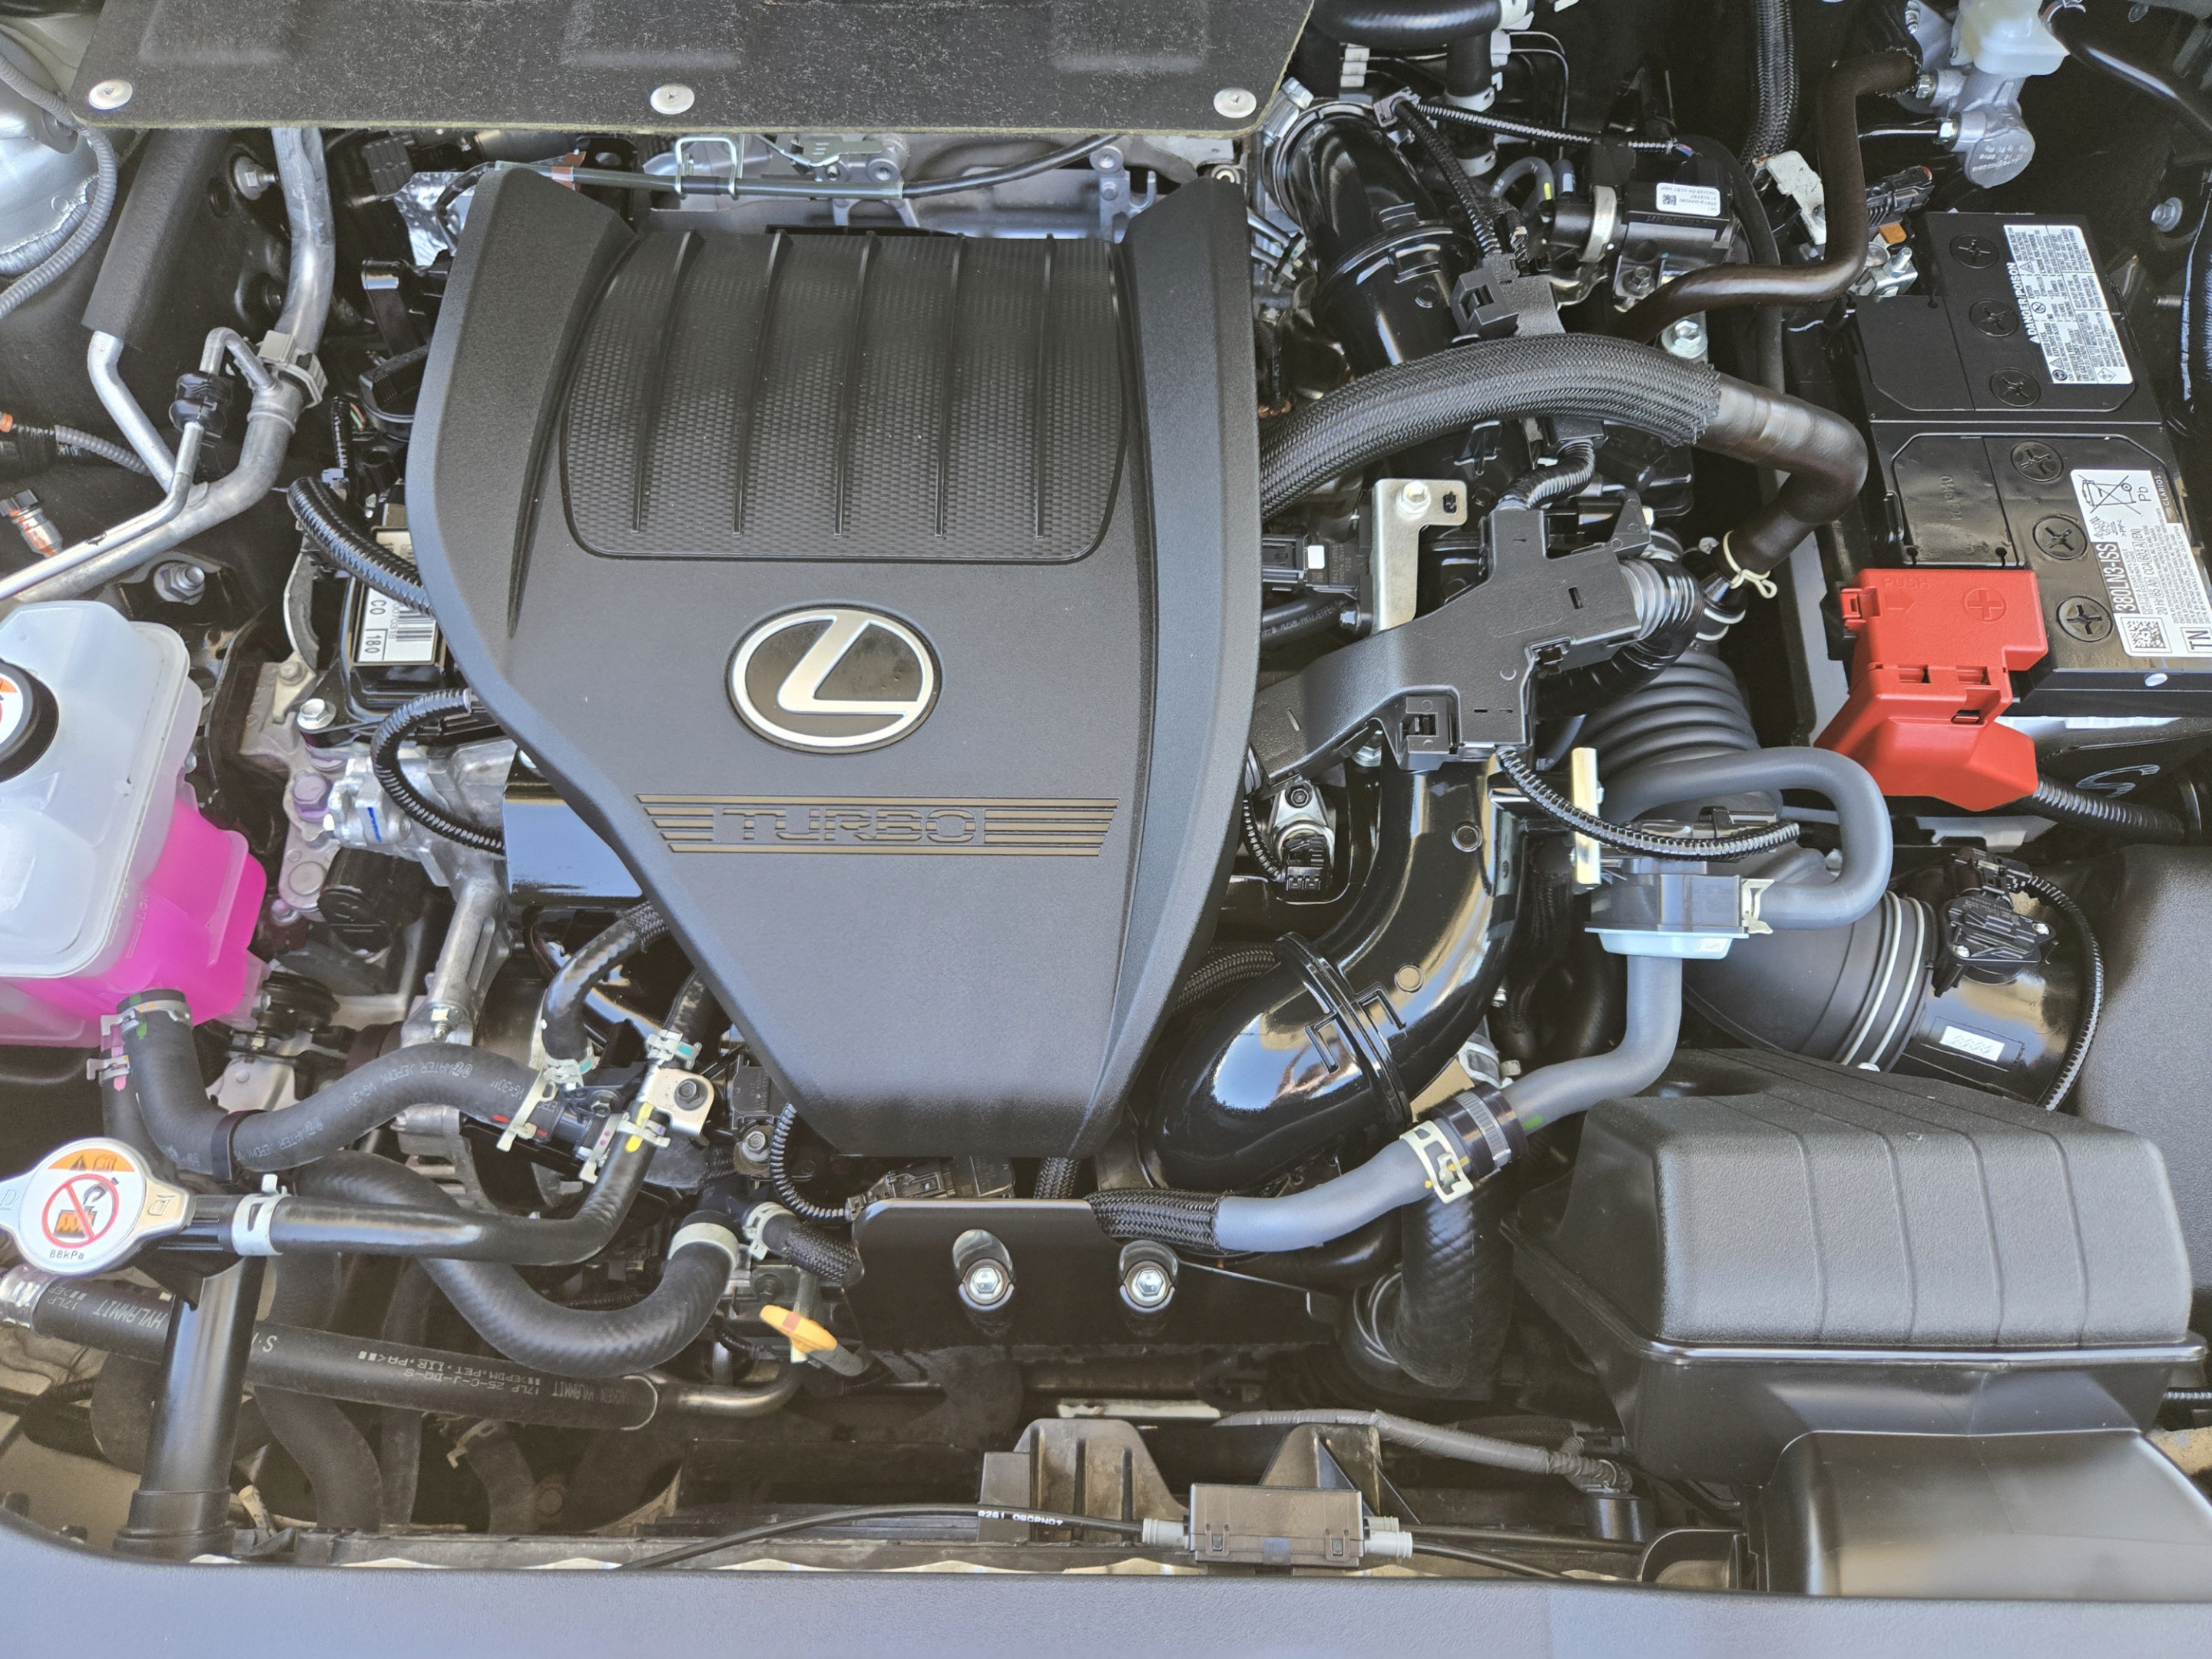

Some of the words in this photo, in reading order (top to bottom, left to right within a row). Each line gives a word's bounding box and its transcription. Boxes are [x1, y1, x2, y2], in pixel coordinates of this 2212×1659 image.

[2006, 263, 2037, 335] DANGER/POISON
[2136, 486, 2151, 502] Pb
[2154, 475, 2170, 506] CLARIOS
[2129, 528, 2145, 540] (EN)
[2136, 548, 2149, 560] 603
[2094, 543, 2136, 611] 380LN3-ISS
[2141, 563, 2155, 575] CCA
[1884, 578, 1929, 588] PUSH
[369, 600, 387, 615] CO
[364, 634, 382, 654] 180
[2185, 630, 2209, 651] TN
[722, 807, 977, 843] TURBO
[48, 1250, 85, 1260] 88kPa
[47, 1296, 79, 1310] 17LP
[92, 1299, 169, 1330] HYLAMMIT
[404, 1367, 506, 1390] 25-C-J-DQ-S
[509, 1384, 539, 1396] 17LP
